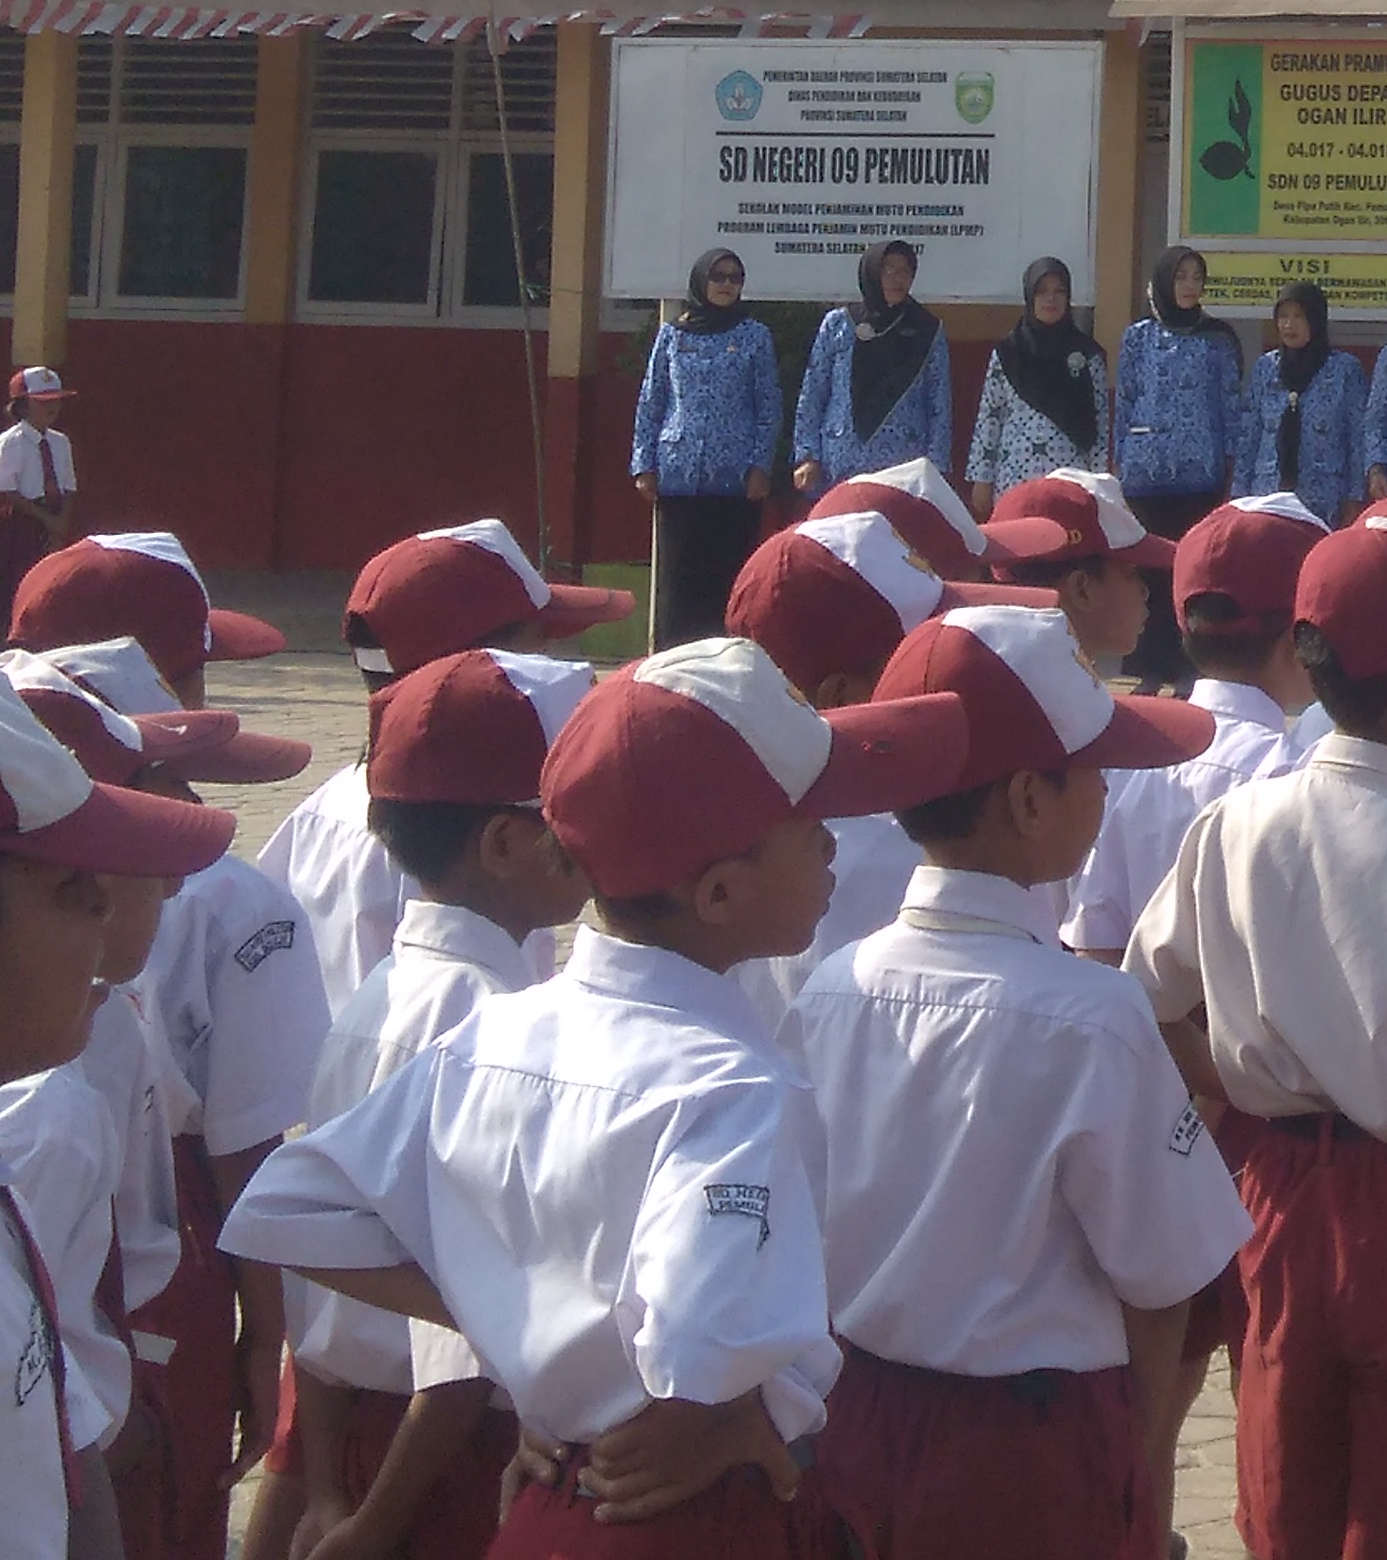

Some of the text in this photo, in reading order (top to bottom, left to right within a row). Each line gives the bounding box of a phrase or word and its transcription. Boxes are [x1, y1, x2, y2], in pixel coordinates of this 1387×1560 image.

[1270, 53, 1340, 72] GERAKAN
[1280, 84, 1340, 102] GUGUS
[1297, 107, 1387, 125] OGAN ILIR
[1287, 142, 1334, 158] 04.017
[719, 145, 990, 186] SD NEGERI 09 PEMULUTAN
[1267, 174, 1298, 191] SDN
[1303, 174, 1321, 191] 09
[1280, 258, 1331, 274] VISI
